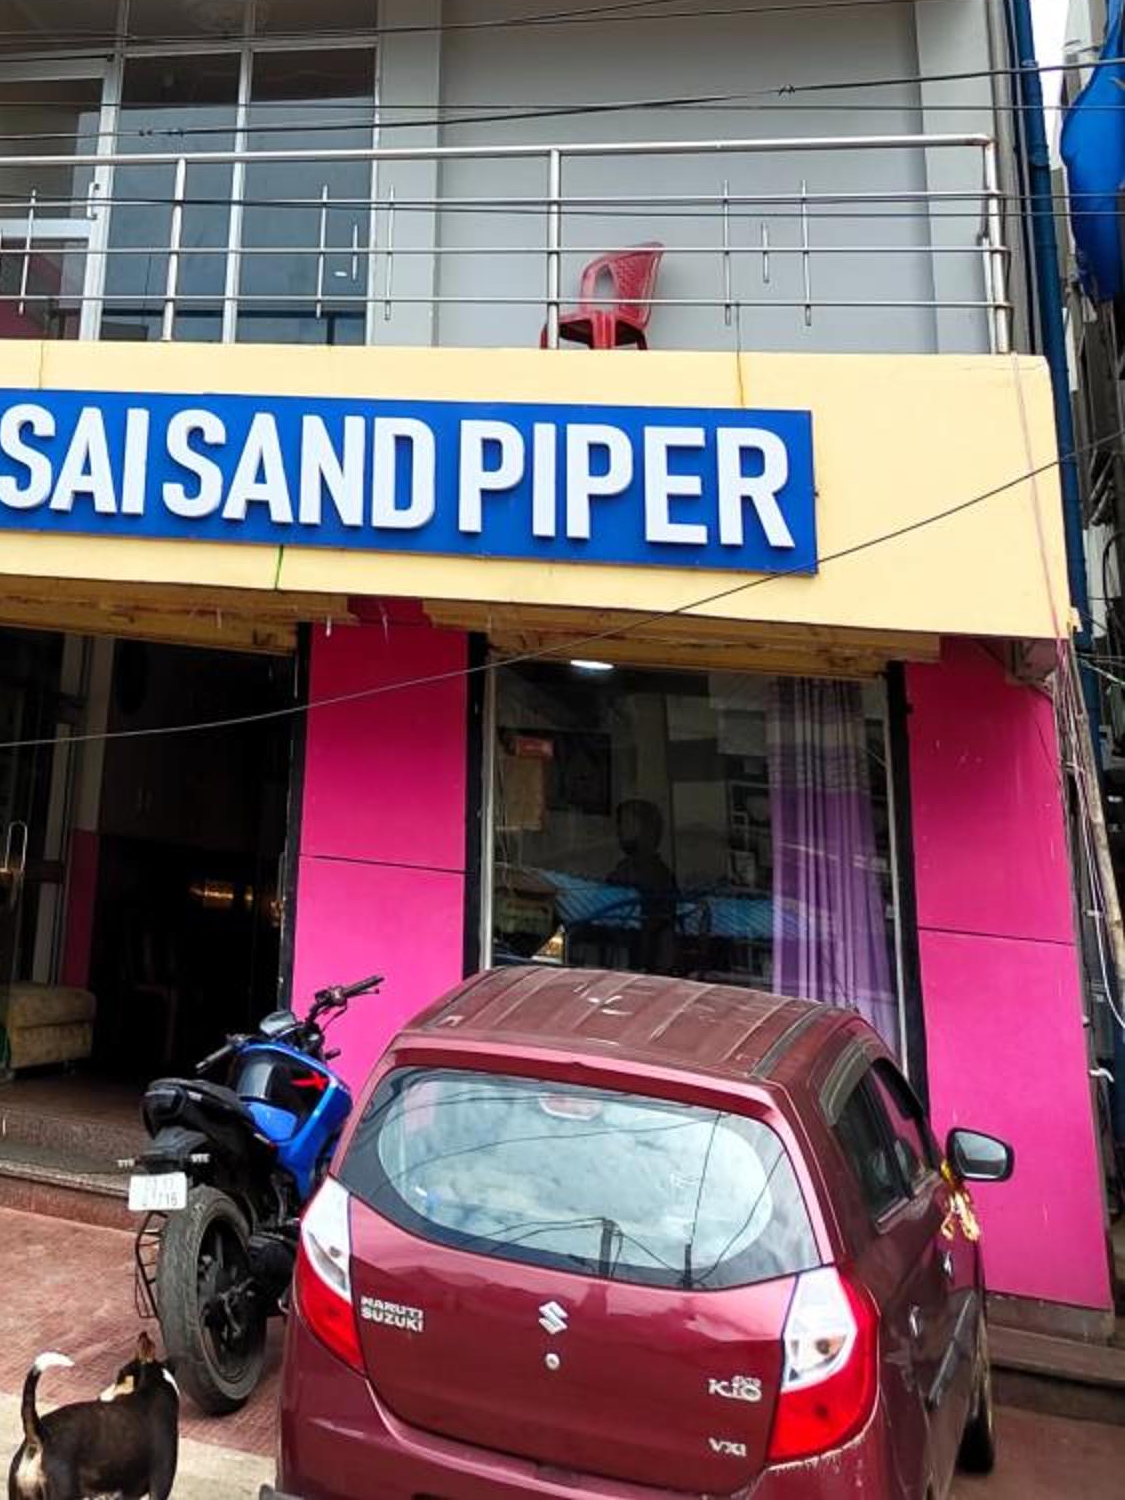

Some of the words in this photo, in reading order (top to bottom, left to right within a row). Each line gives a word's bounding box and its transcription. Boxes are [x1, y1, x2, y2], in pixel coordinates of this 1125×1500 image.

[162, 409, 436, 529] SAND
[458, 419, 796, 548] PIPER
[360, 1295, 424, 1319] MARUTI
[360, 1306, 424, 1332] SUZUKI
